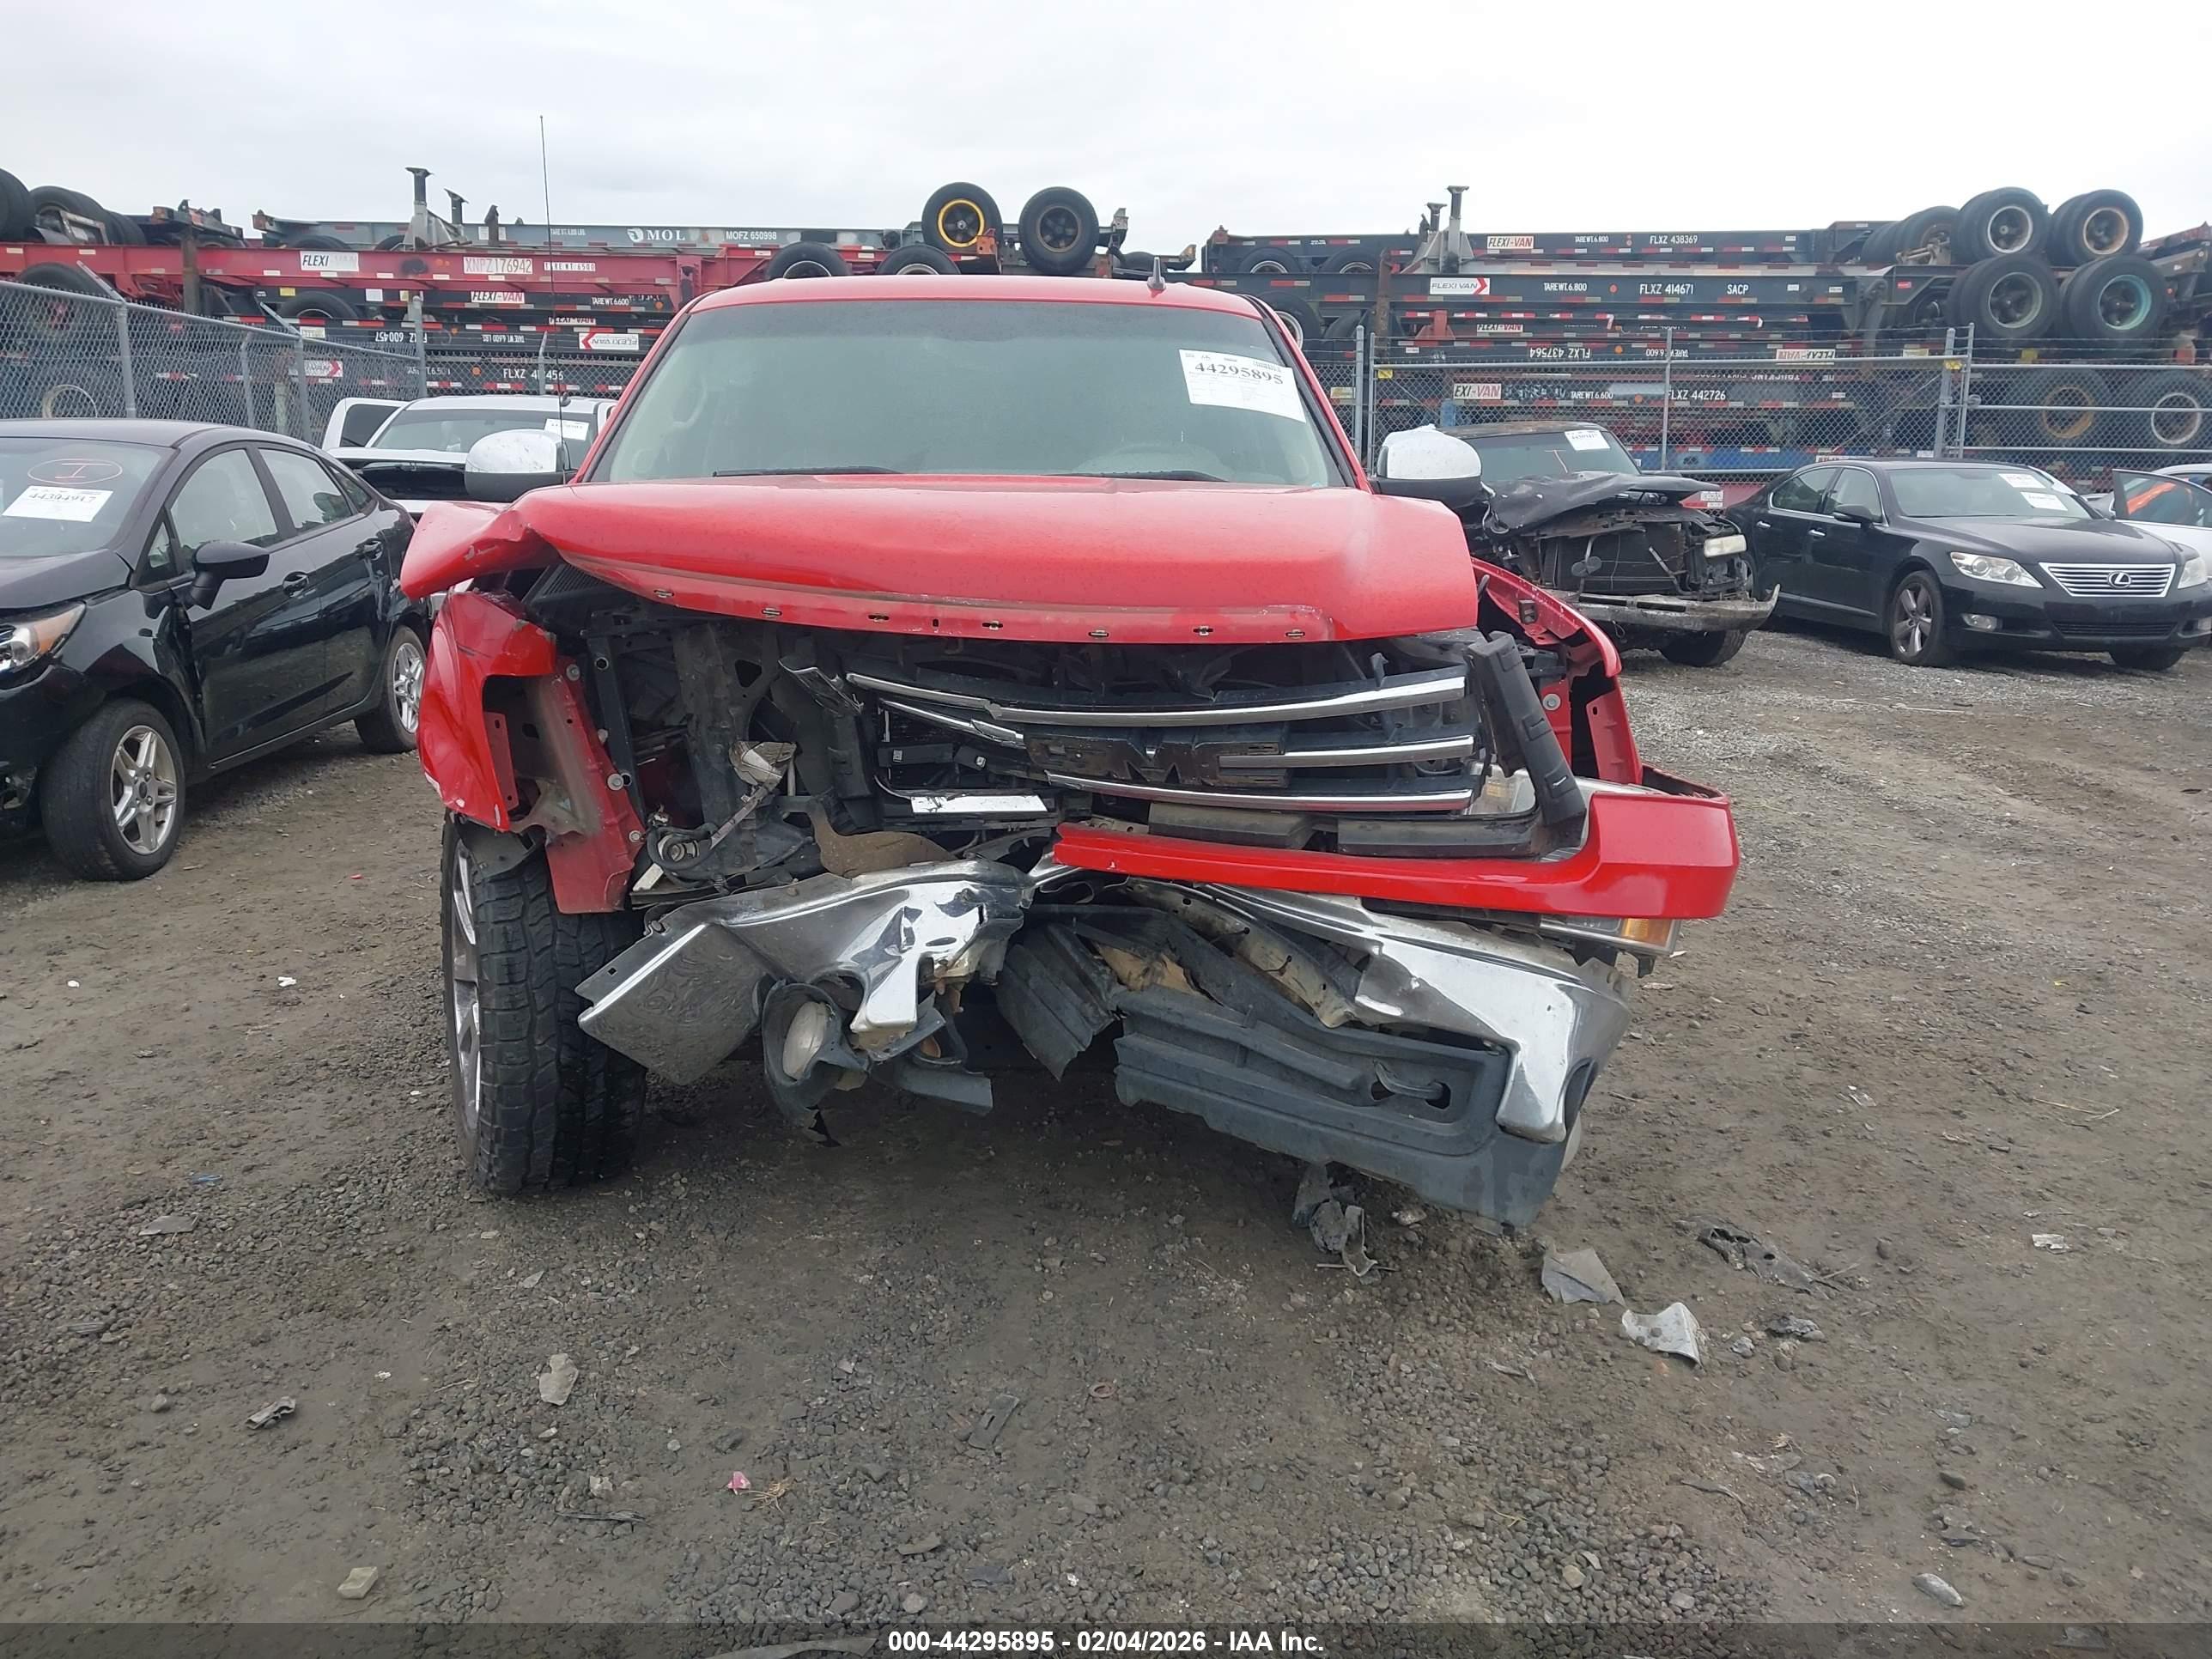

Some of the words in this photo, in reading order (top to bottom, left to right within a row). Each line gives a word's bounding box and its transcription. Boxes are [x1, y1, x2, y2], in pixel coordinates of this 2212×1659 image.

[646, 230, 685, 240] MOL
[726, 230, 749, 240] MOFZ
[1650, 235, 1668, 244] FLXZ
[1671, 235, 1698, 244] 438369
[1488, 237, 1533, 247] FLEXI-VAN
[1639, 283, 1662, 295] FLXZ
[1665, 283, 1694, 295] 414671
[1727, 284, 1749, 295] SACP
[1530, 347, 1565, 359] 437564
[1568, 347, 1590, 359] FLXZ
[503, 368, 526, 378] FLXZ
[1195, 362, 1283, 385] 44295895
[1692, 390, 1726, 400] 442726
